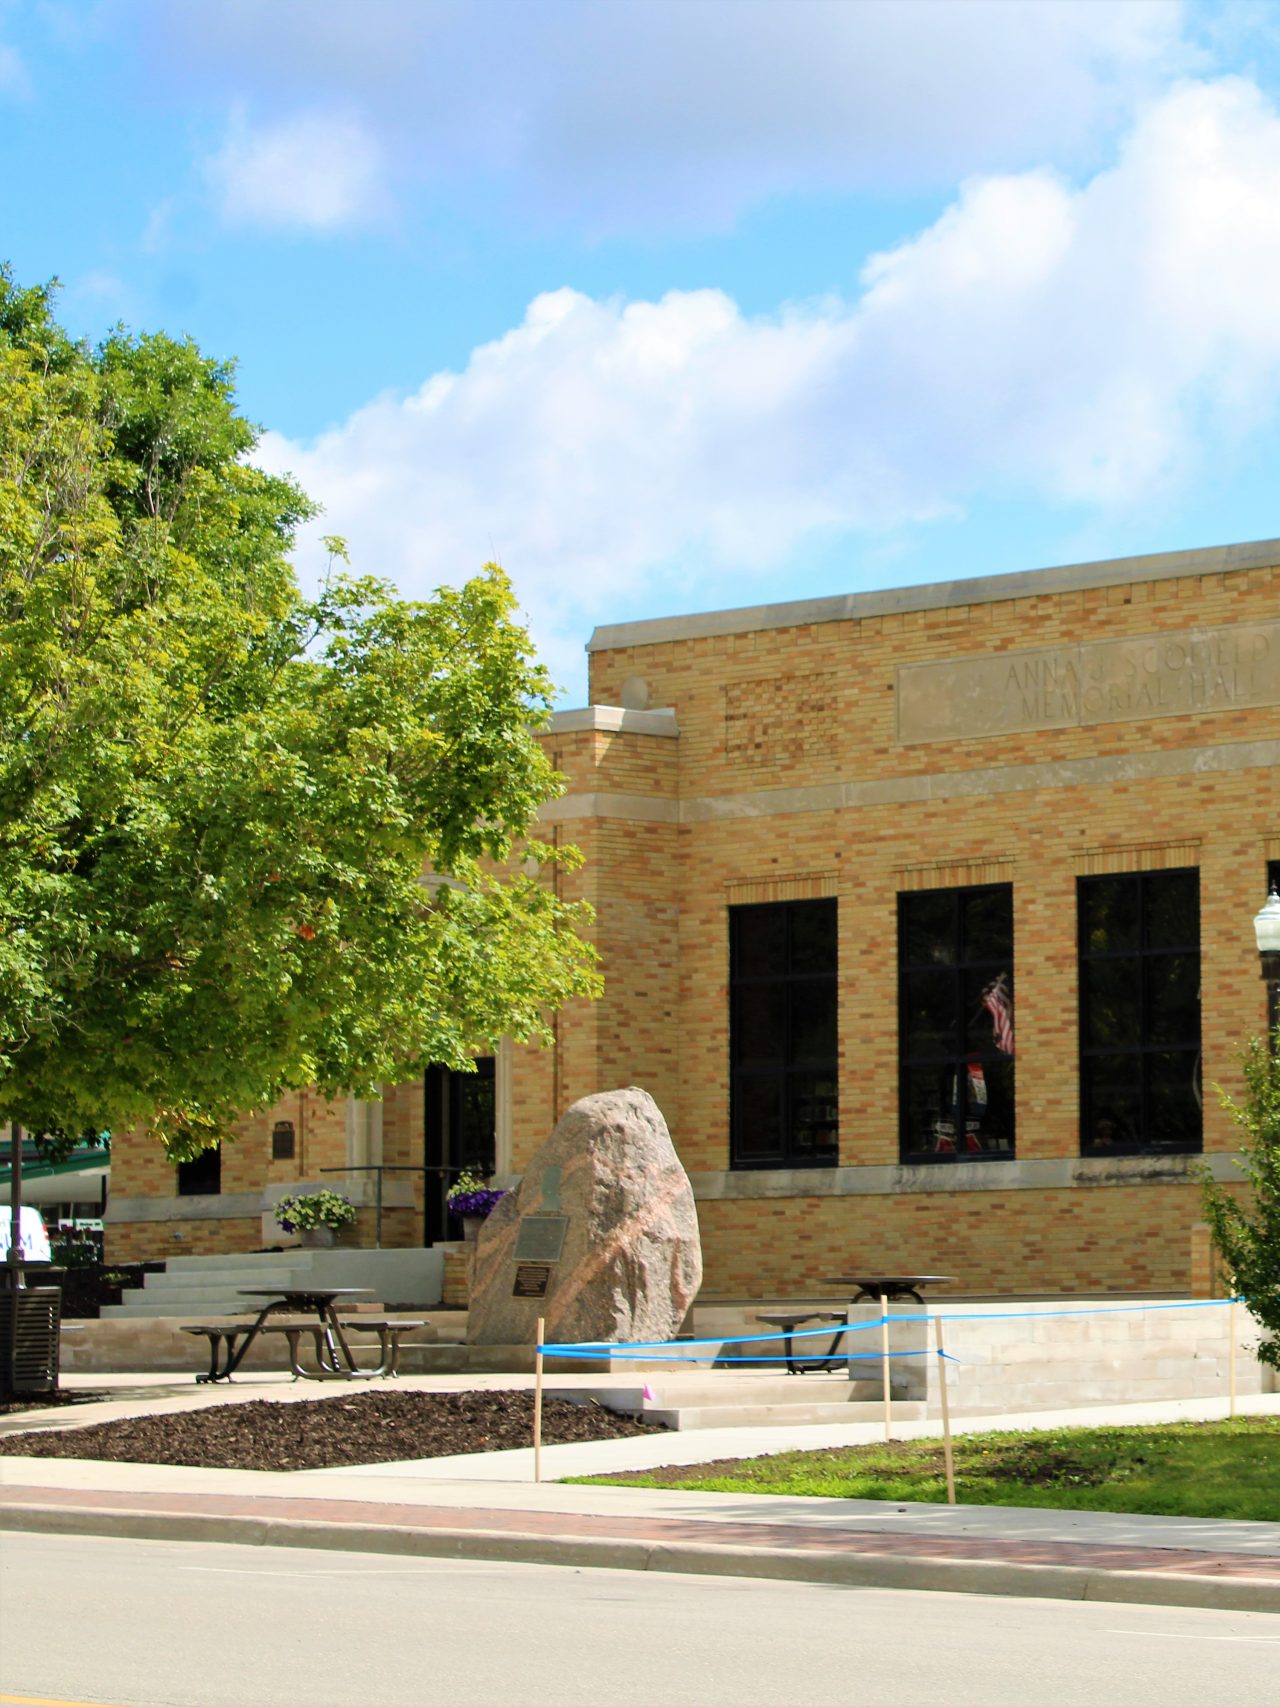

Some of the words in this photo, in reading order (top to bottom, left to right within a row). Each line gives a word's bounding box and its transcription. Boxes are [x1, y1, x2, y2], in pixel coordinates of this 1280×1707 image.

[1005, 657, 1080, 691] ANNA
[1126, 633, 1271, 678] SCOFIELD
[1021, 677, 1169, 721] MEMORIAL
[1190, 668, 1262, 703] HALL
